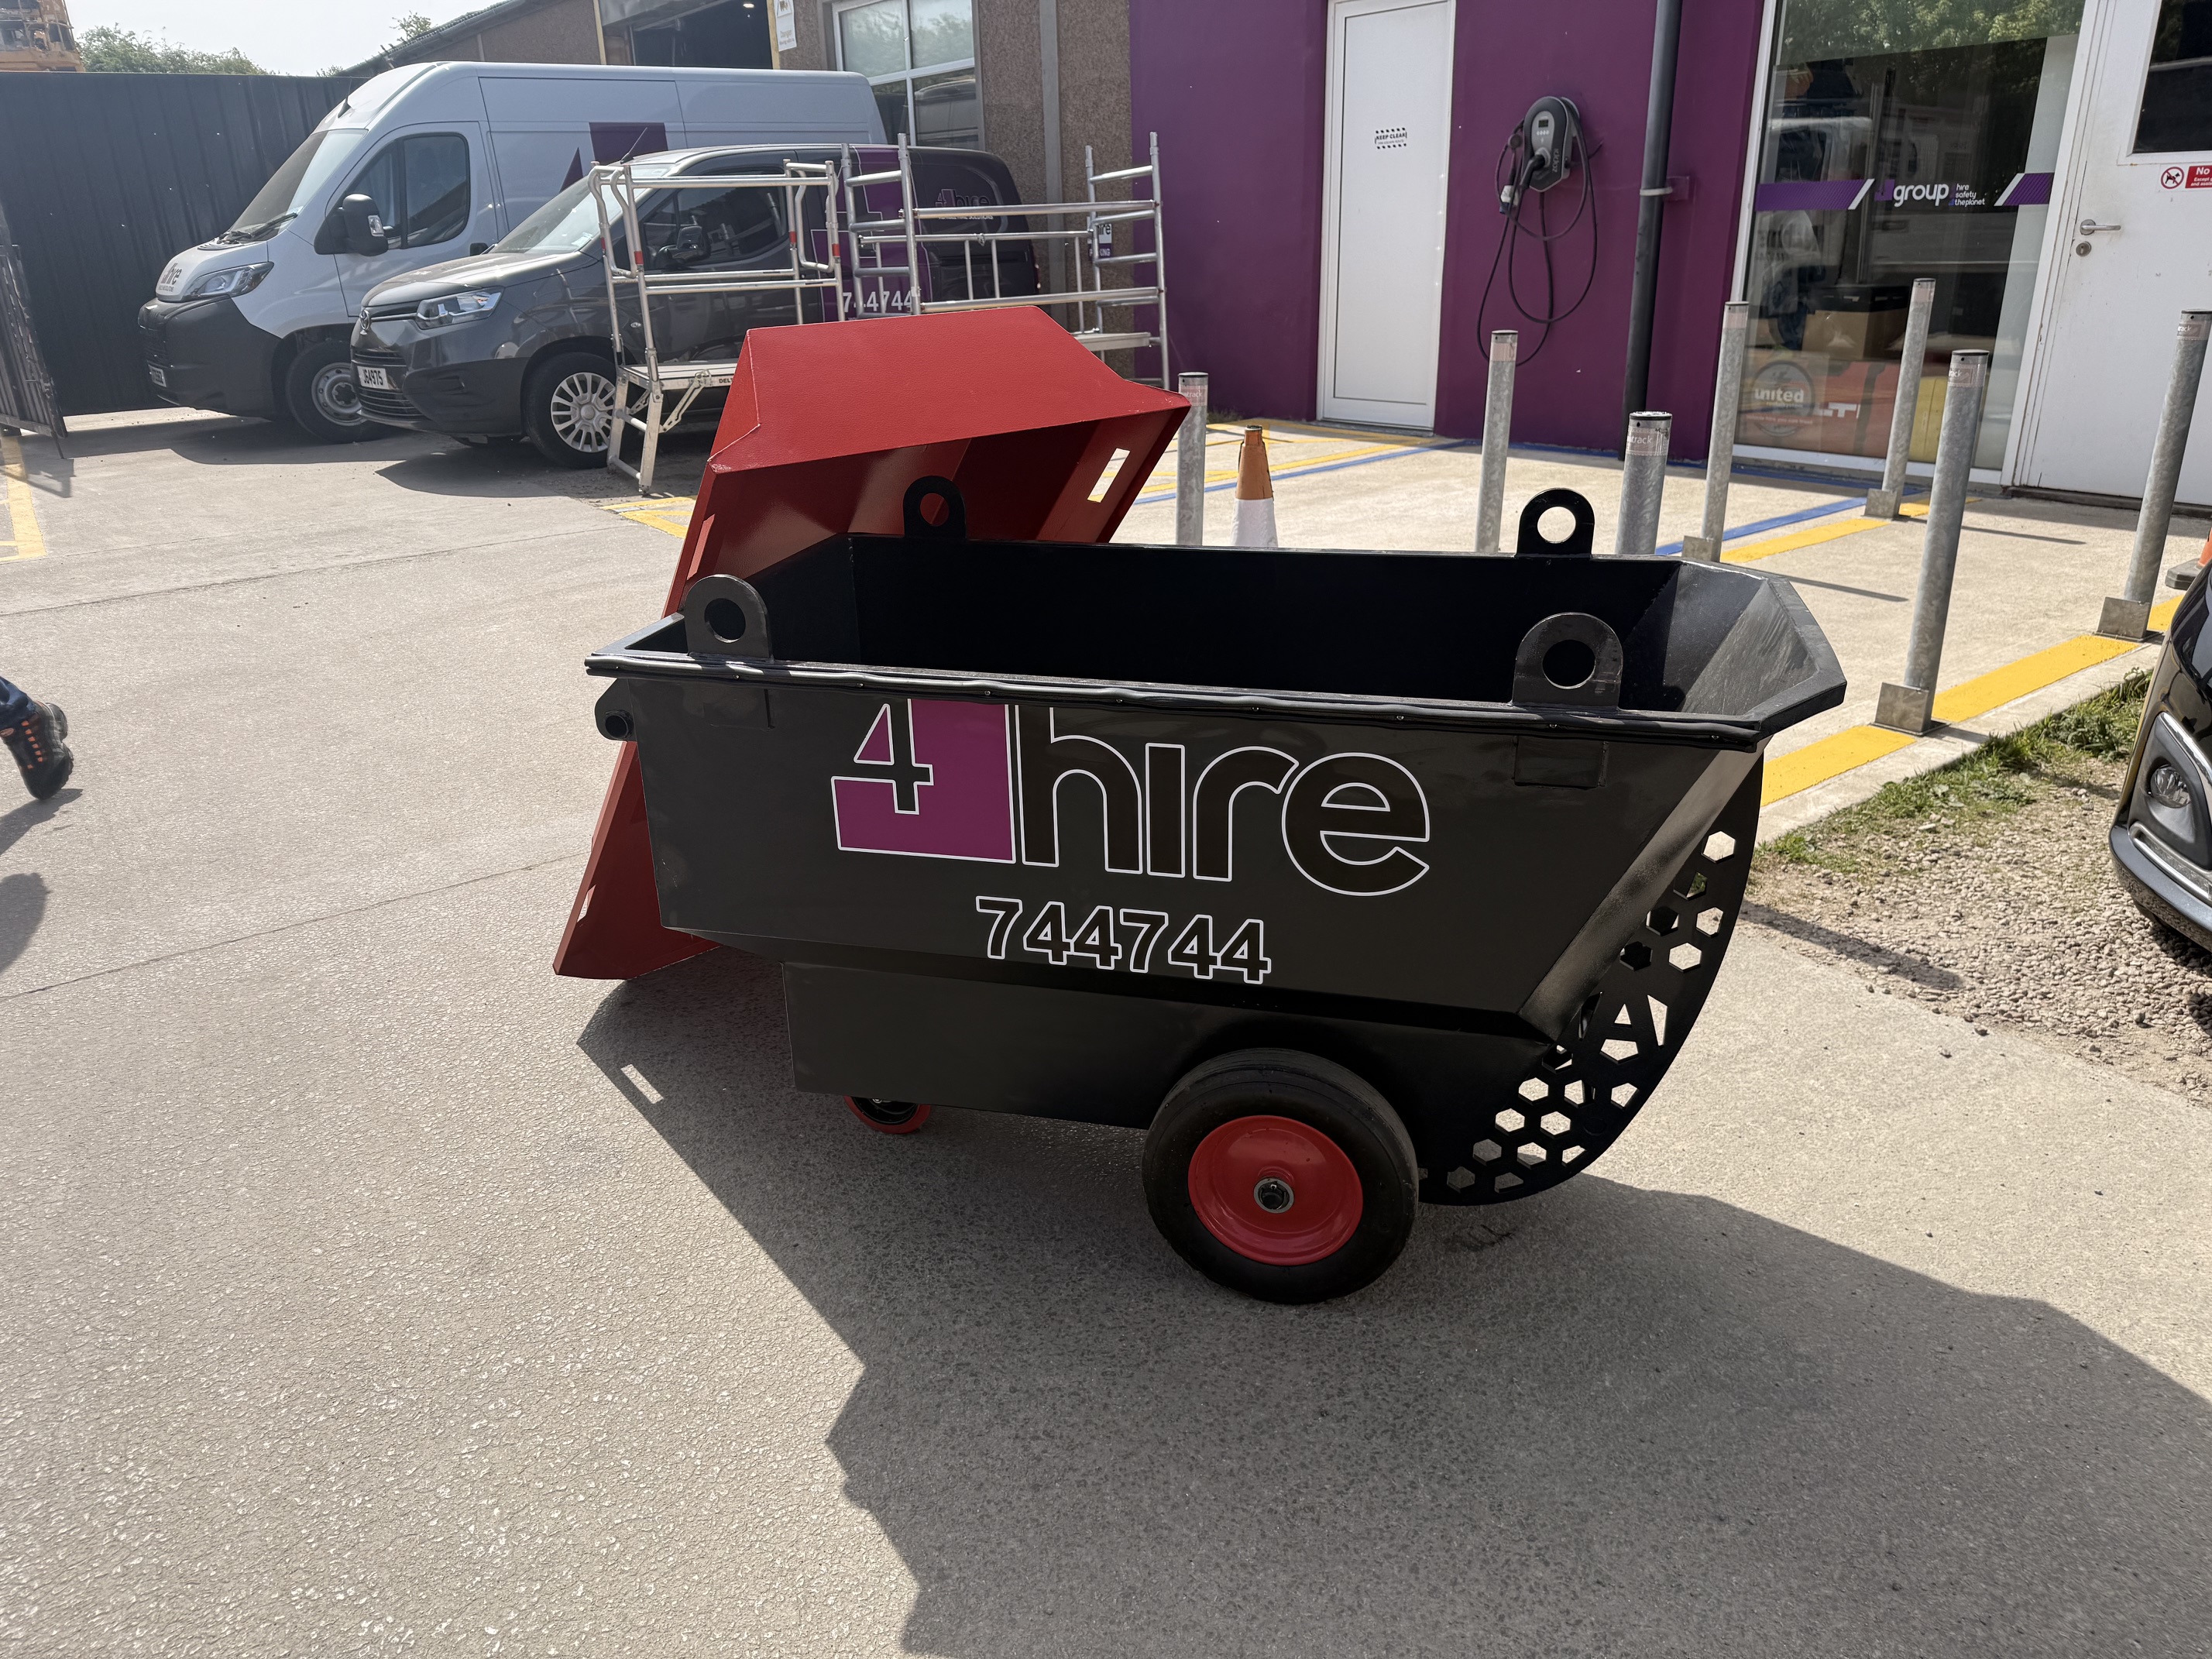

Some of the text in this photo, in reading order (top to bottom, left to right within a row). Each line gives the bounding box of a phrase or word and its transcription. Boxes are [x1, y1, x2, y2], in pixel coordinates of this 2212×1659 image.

[2196, 167, 2210, 175] No
[1955, 191, 1977, 199] safety
[1754, 388, 1805, 404] united
[831, 698, 1431, 897] 4hire
[976, 895, 1271, 985] 744744
